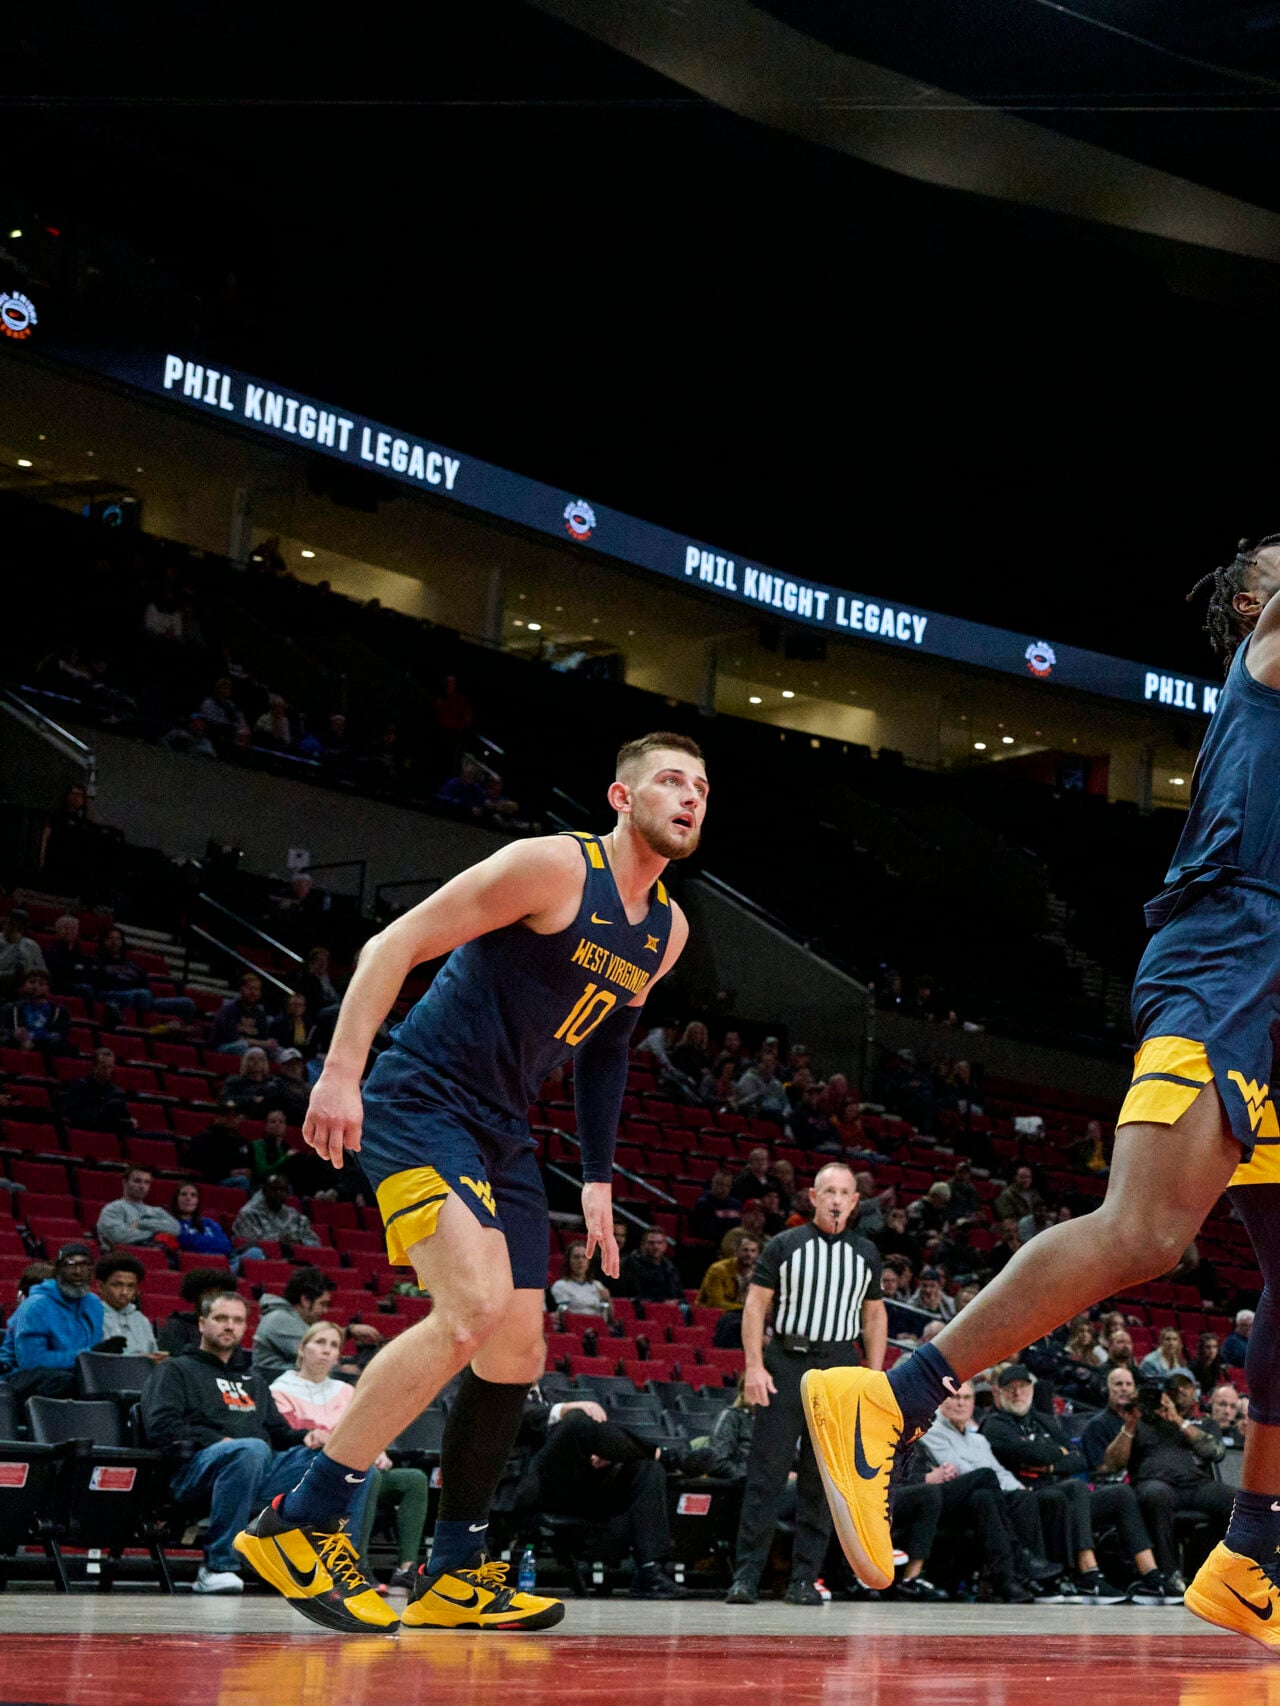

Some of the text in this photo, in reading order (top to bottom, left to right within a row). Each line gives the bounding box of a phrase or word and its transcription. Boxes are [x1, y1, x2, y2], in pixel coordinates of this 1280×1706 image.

[163, 354, 460, 490] PHIL KNIGHT LEGACY
[685, 545, 928, 644] PHIL KNIGHT LEGACY
[1144, 672, 1197, 710] PHIL
[571, 938, 610, 974] WEST
[554, 982, 617, 1046] 10
